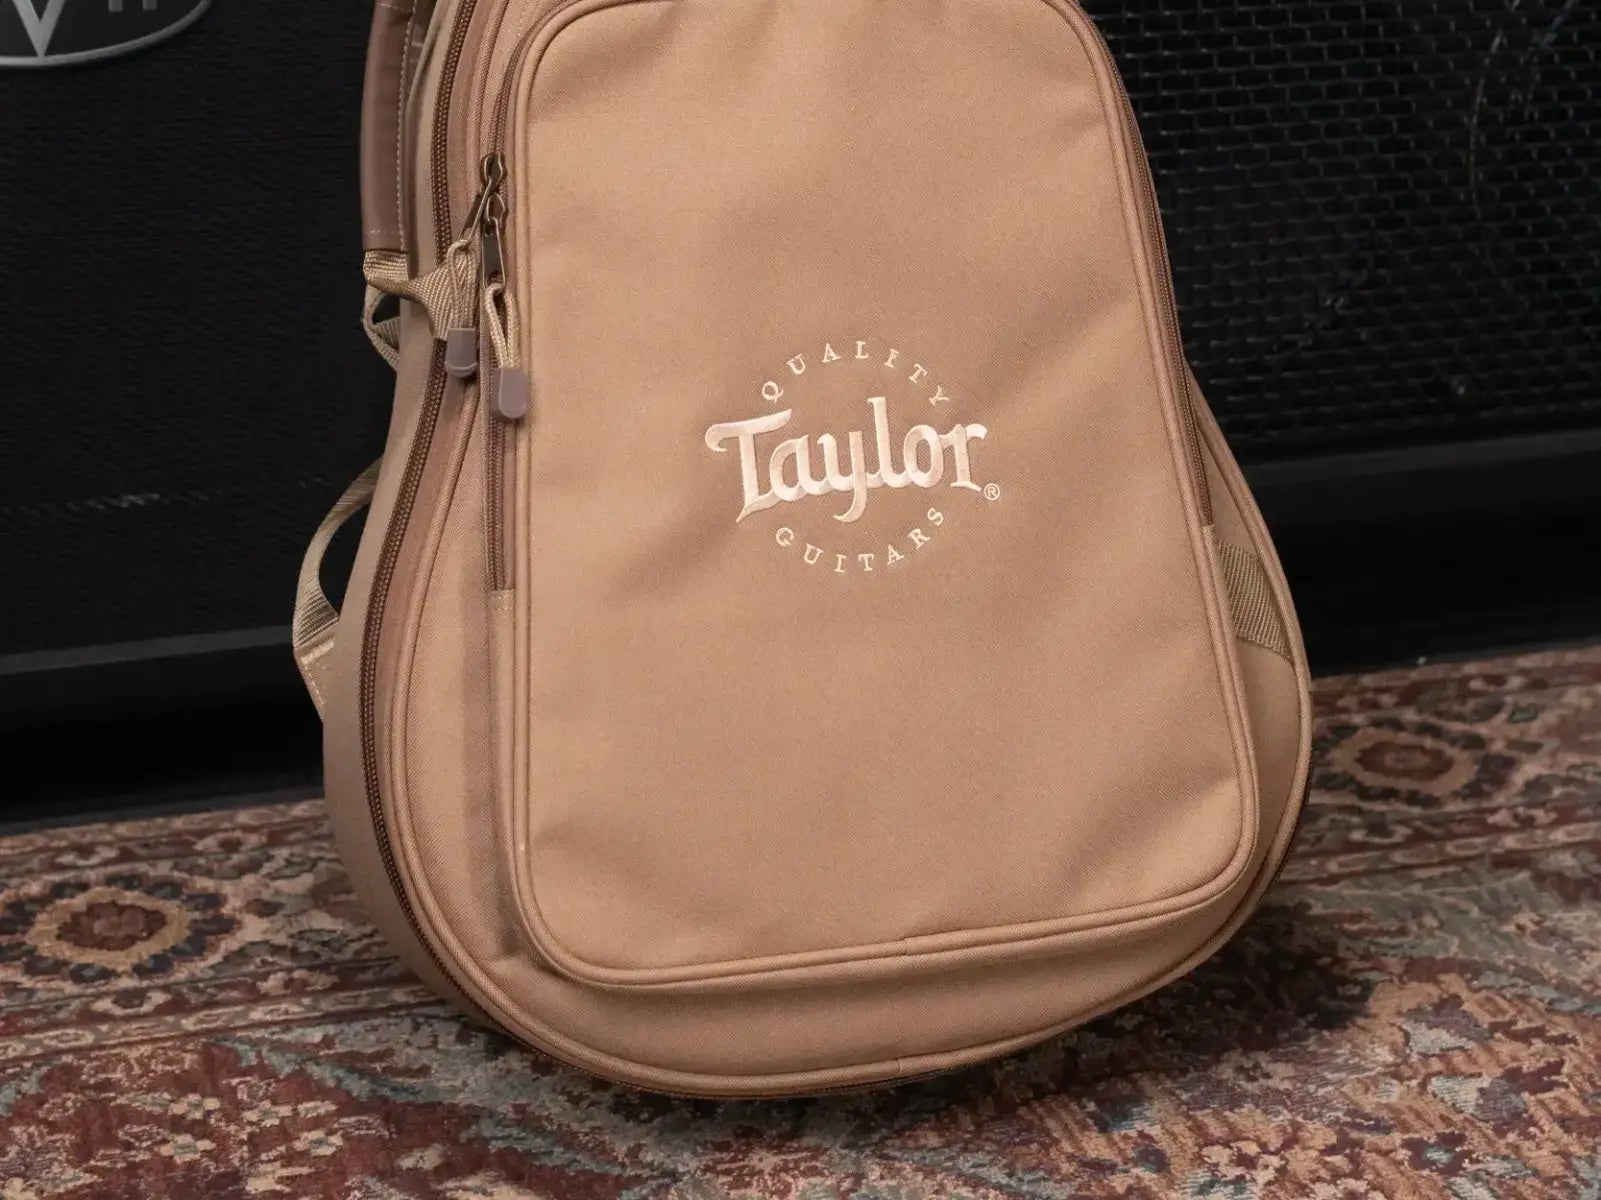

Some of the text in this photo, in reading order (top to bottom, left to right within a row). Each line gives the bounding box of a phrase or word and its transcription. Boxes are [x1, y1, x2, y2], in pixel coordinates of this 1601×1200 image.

[761, 340, 949, 407] QUALITY
[704, 396, 988, 523] Taylor
[775, 508, 944, 573] GUITARS
